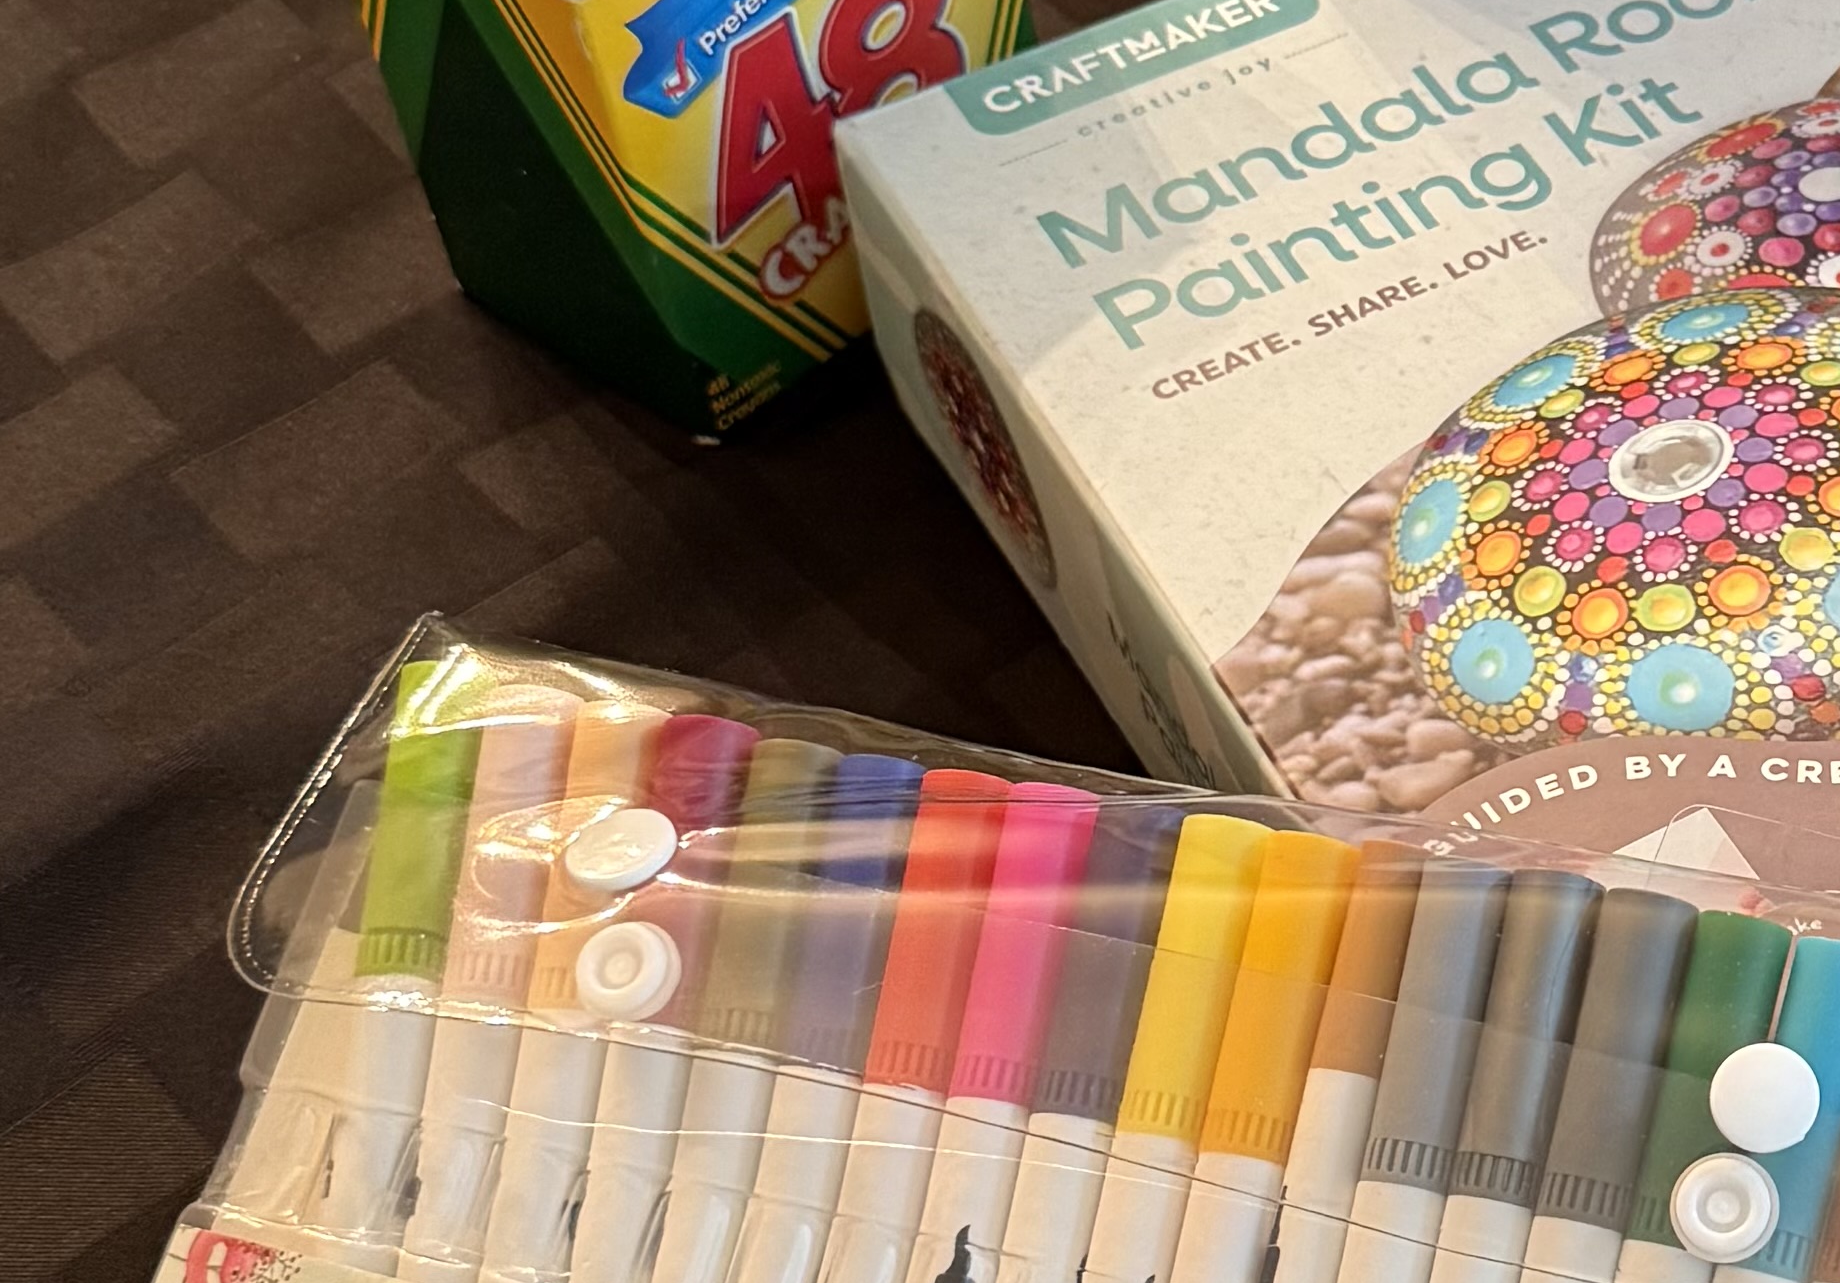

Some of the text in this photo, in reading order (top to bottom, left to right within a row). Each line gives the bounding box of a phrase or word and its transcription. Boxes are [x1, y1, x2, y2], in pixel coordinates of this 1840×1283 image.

[1035, 49, 1539, 270] Mandala
[1076, 57, 1271, 138] creative joy
[1092, 73, 1704, 351] Painting Kit
[1151, 230, 1551, 402] CREATE. SHARE. LOVE.
[1624, 753, 1687, 782] BY
[1707, 753, 1738, 779] A
